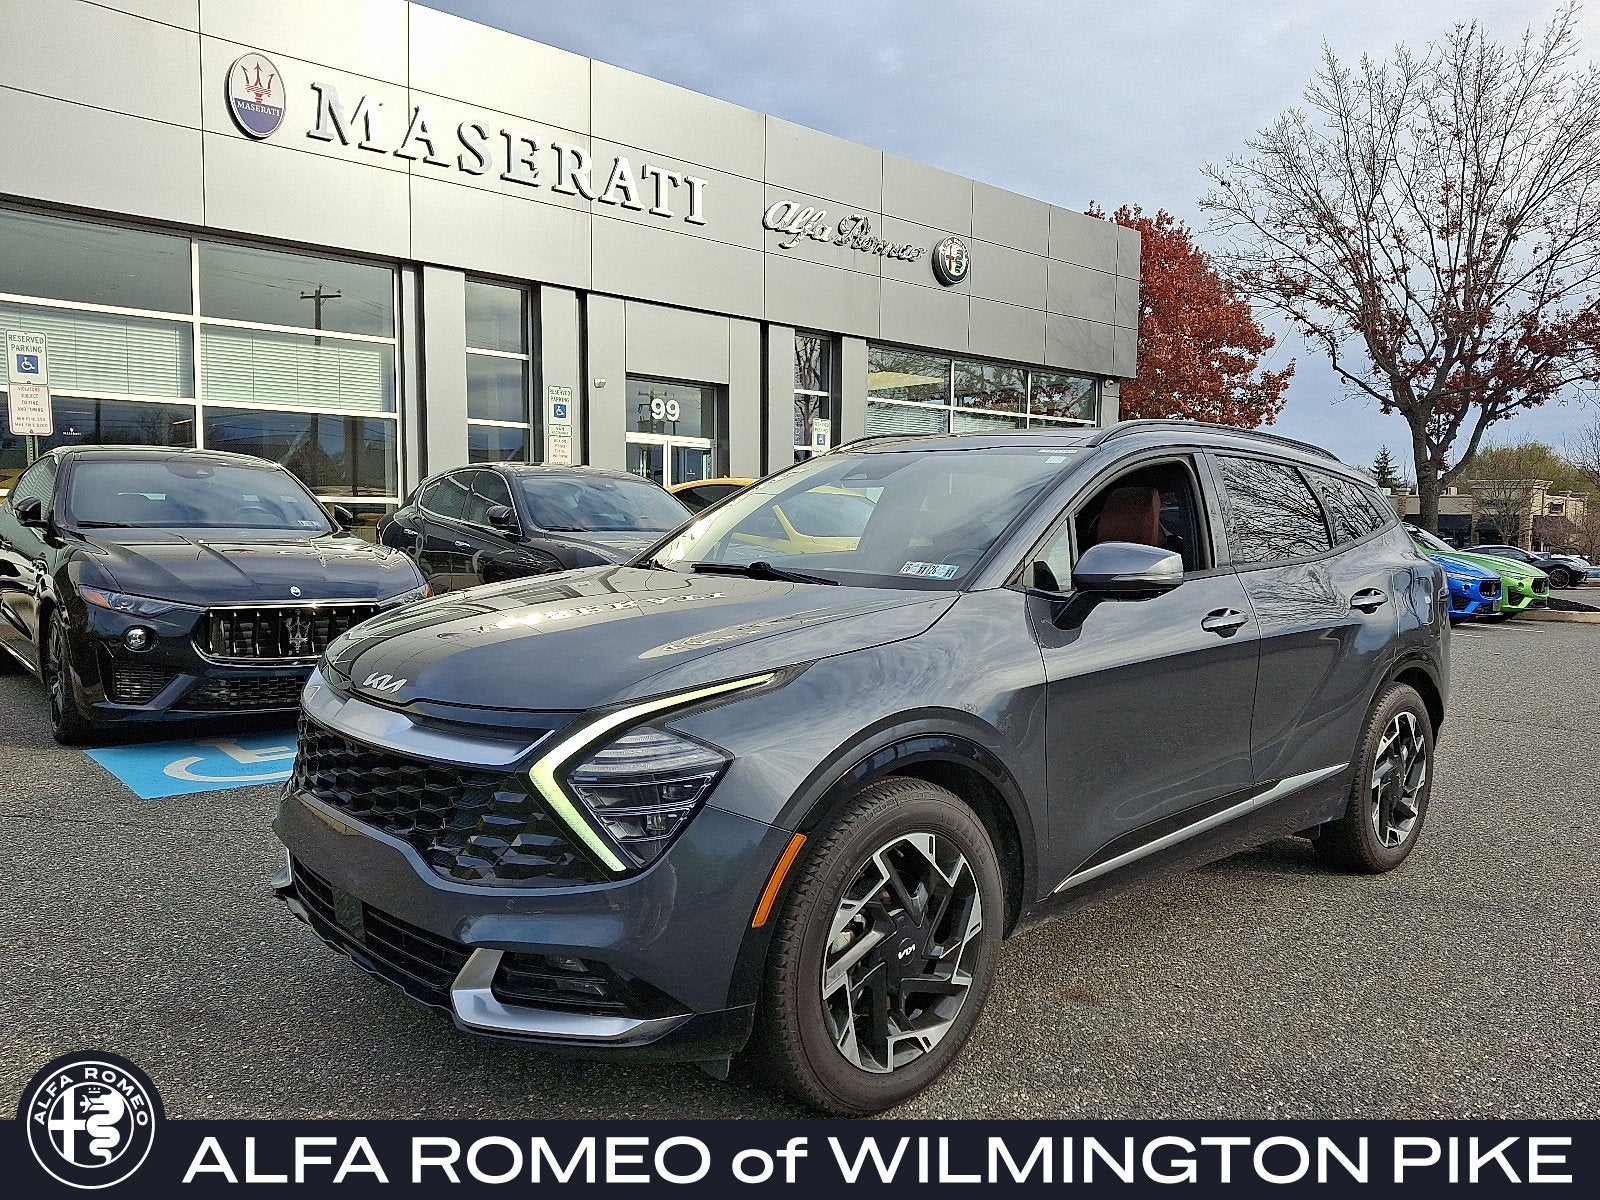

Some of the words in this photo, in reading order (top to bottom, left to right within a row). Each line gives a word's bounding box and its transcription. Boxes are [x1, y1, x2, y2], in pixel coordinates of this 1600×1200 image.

[236, 99, 281, 117] MASERATI
[306, 82, 708, 225] MASERATI
[762, 200, 833, 249] Alfa
[833, 213, 927, 262] Romeo
[8, 334, 44, 345] RESERVED
[10, 343, 43, 354] PARKING
[651, 398, 680, 422] 99
[362, 671, 407, 694] KIA
